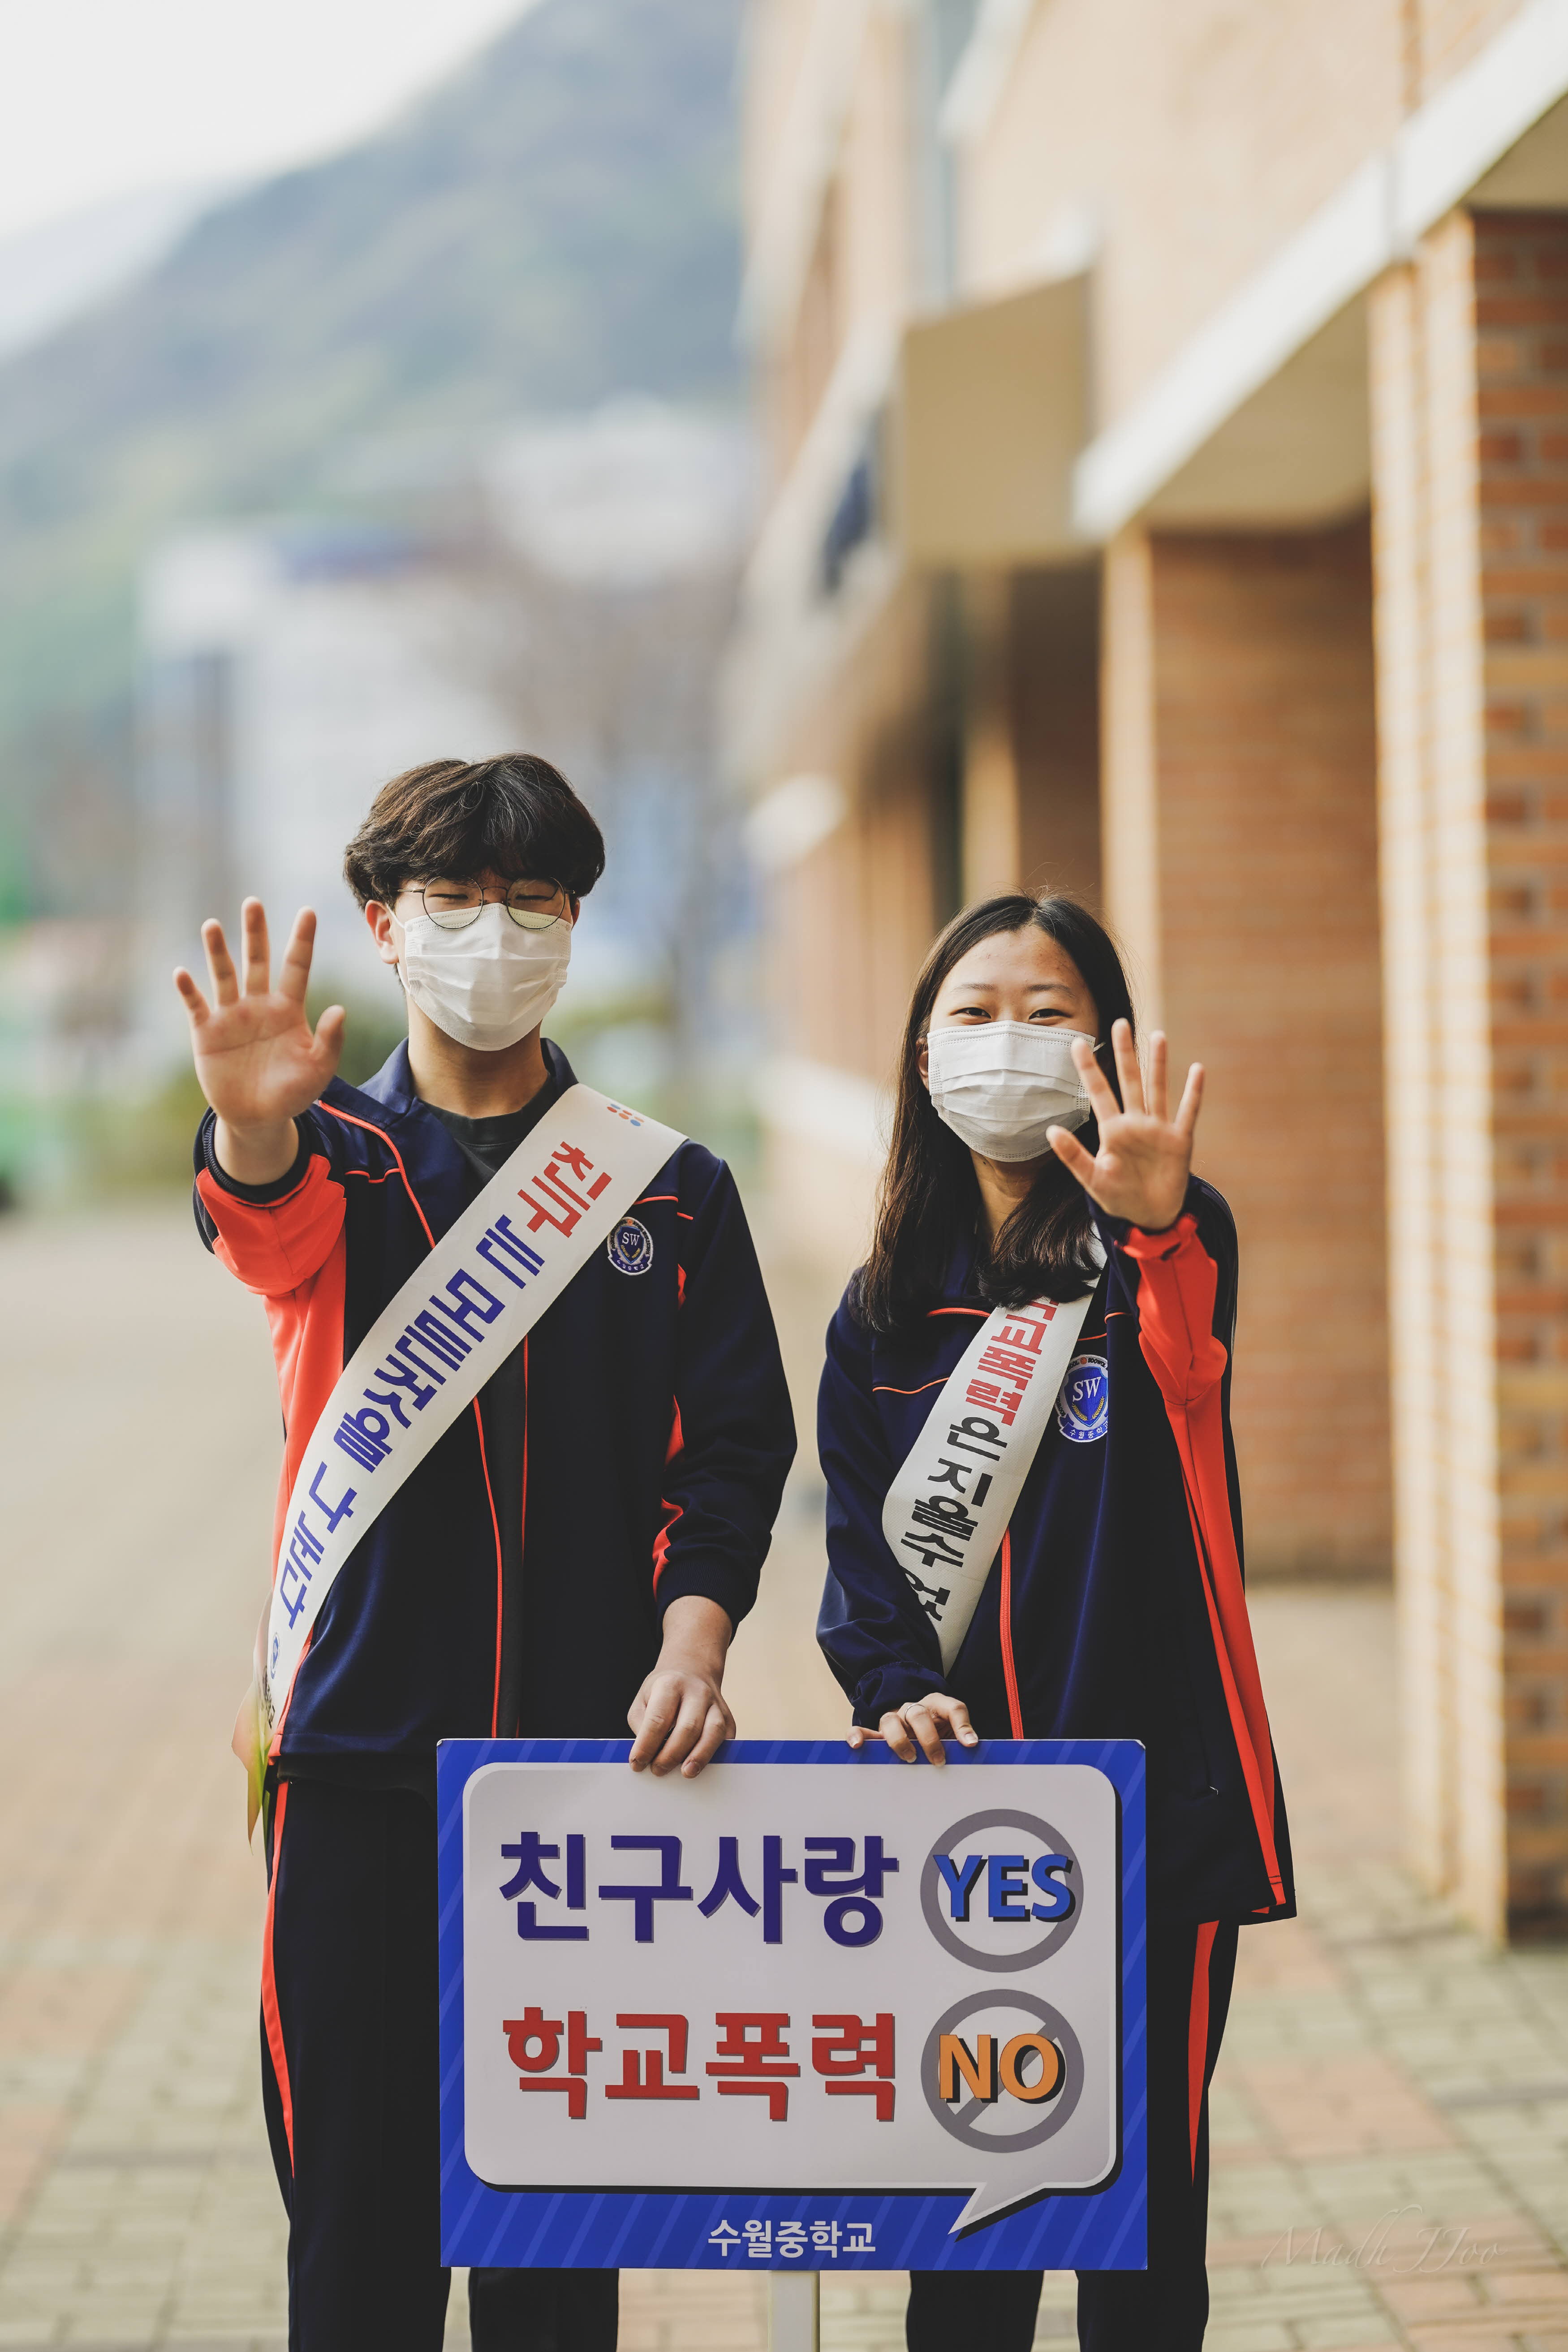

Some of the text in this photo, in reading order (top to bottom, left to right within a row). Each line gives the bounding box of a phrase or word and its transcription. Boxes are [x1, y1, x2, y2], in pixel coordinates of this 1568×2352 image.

[475, 1141, 613, 1289] 친구는
[622, 1232, 640, 1246] SW
[1073, 1376, 1102, 1402] SW
[279, 1461, 358, 1630] 나눈다
[499, 1831, 1076, 1947] 친구사랑 YES
[502, 2006, 1065, 2122] 학교폭력 NO
[707, 2218, 876, 2259] 수월중학교
